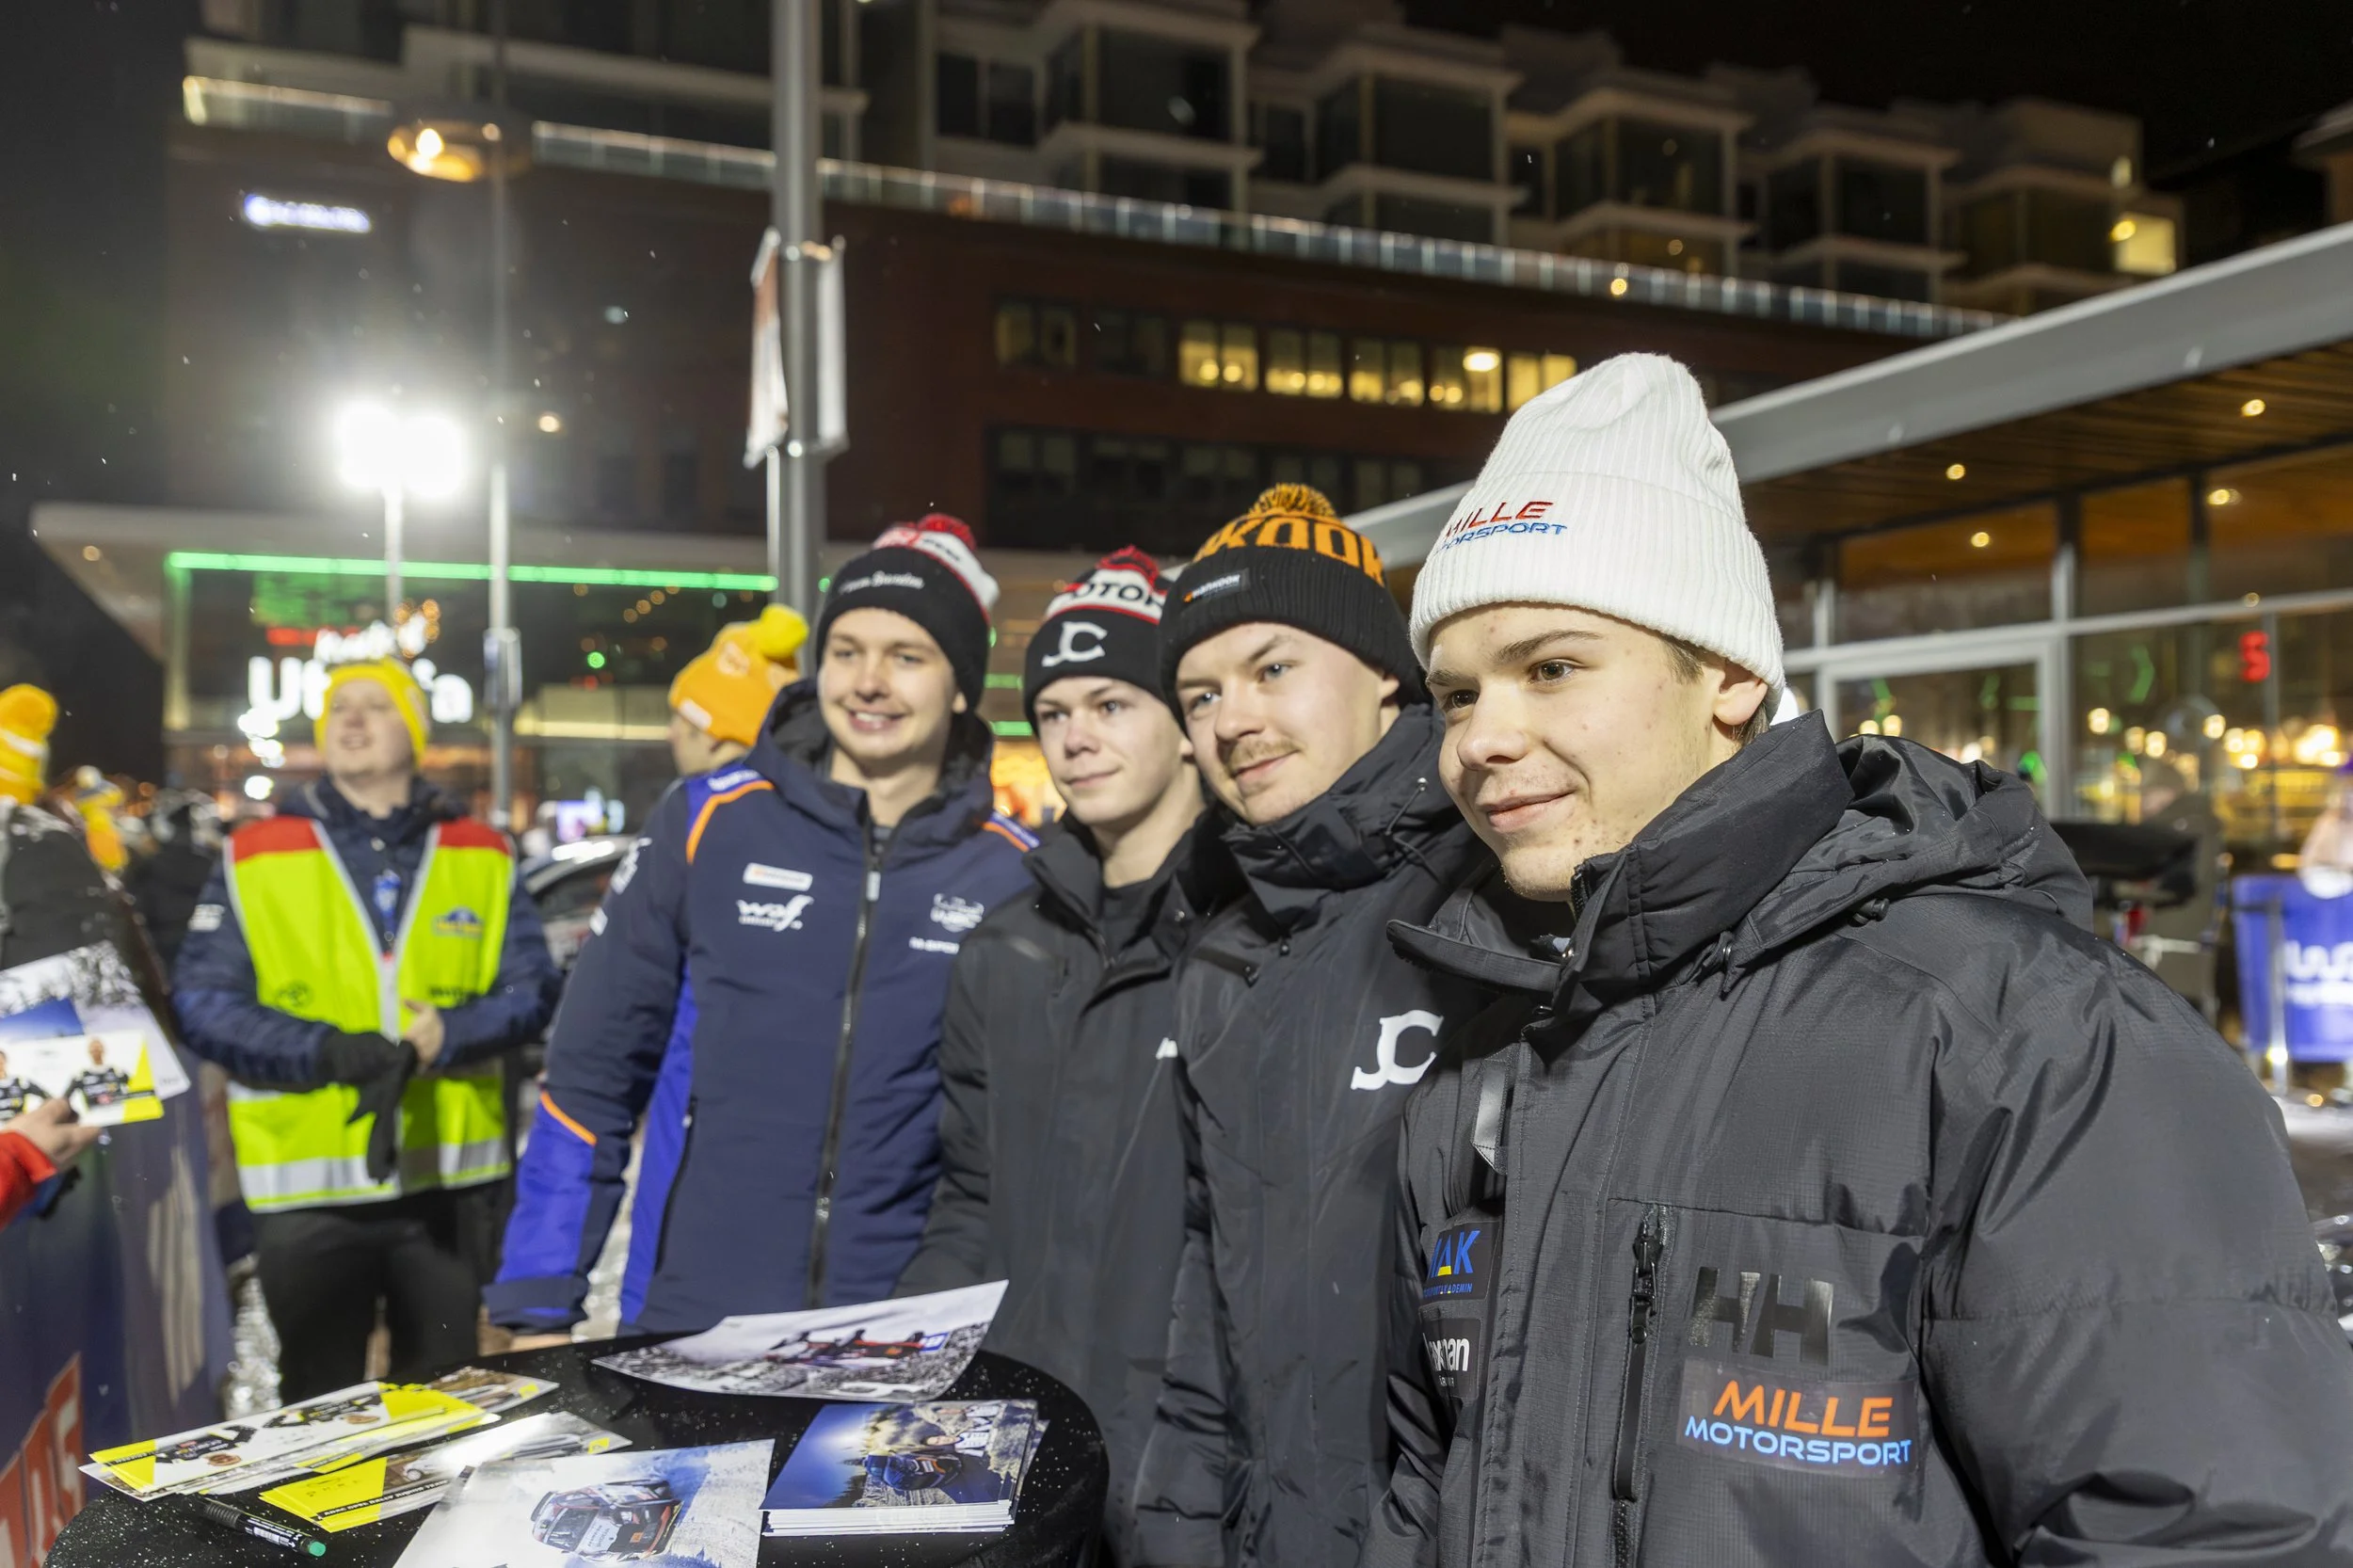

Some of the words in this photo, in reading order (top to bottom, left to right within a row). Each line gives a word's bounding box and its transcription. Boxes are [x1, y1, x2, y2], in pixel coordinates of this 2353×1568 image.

[1193, 516, 1385, 588] KOOK
[1713, 1379, 1894, 1438] MILLE
[1685, 1415, 1913, 1465] MOTORSPORT
